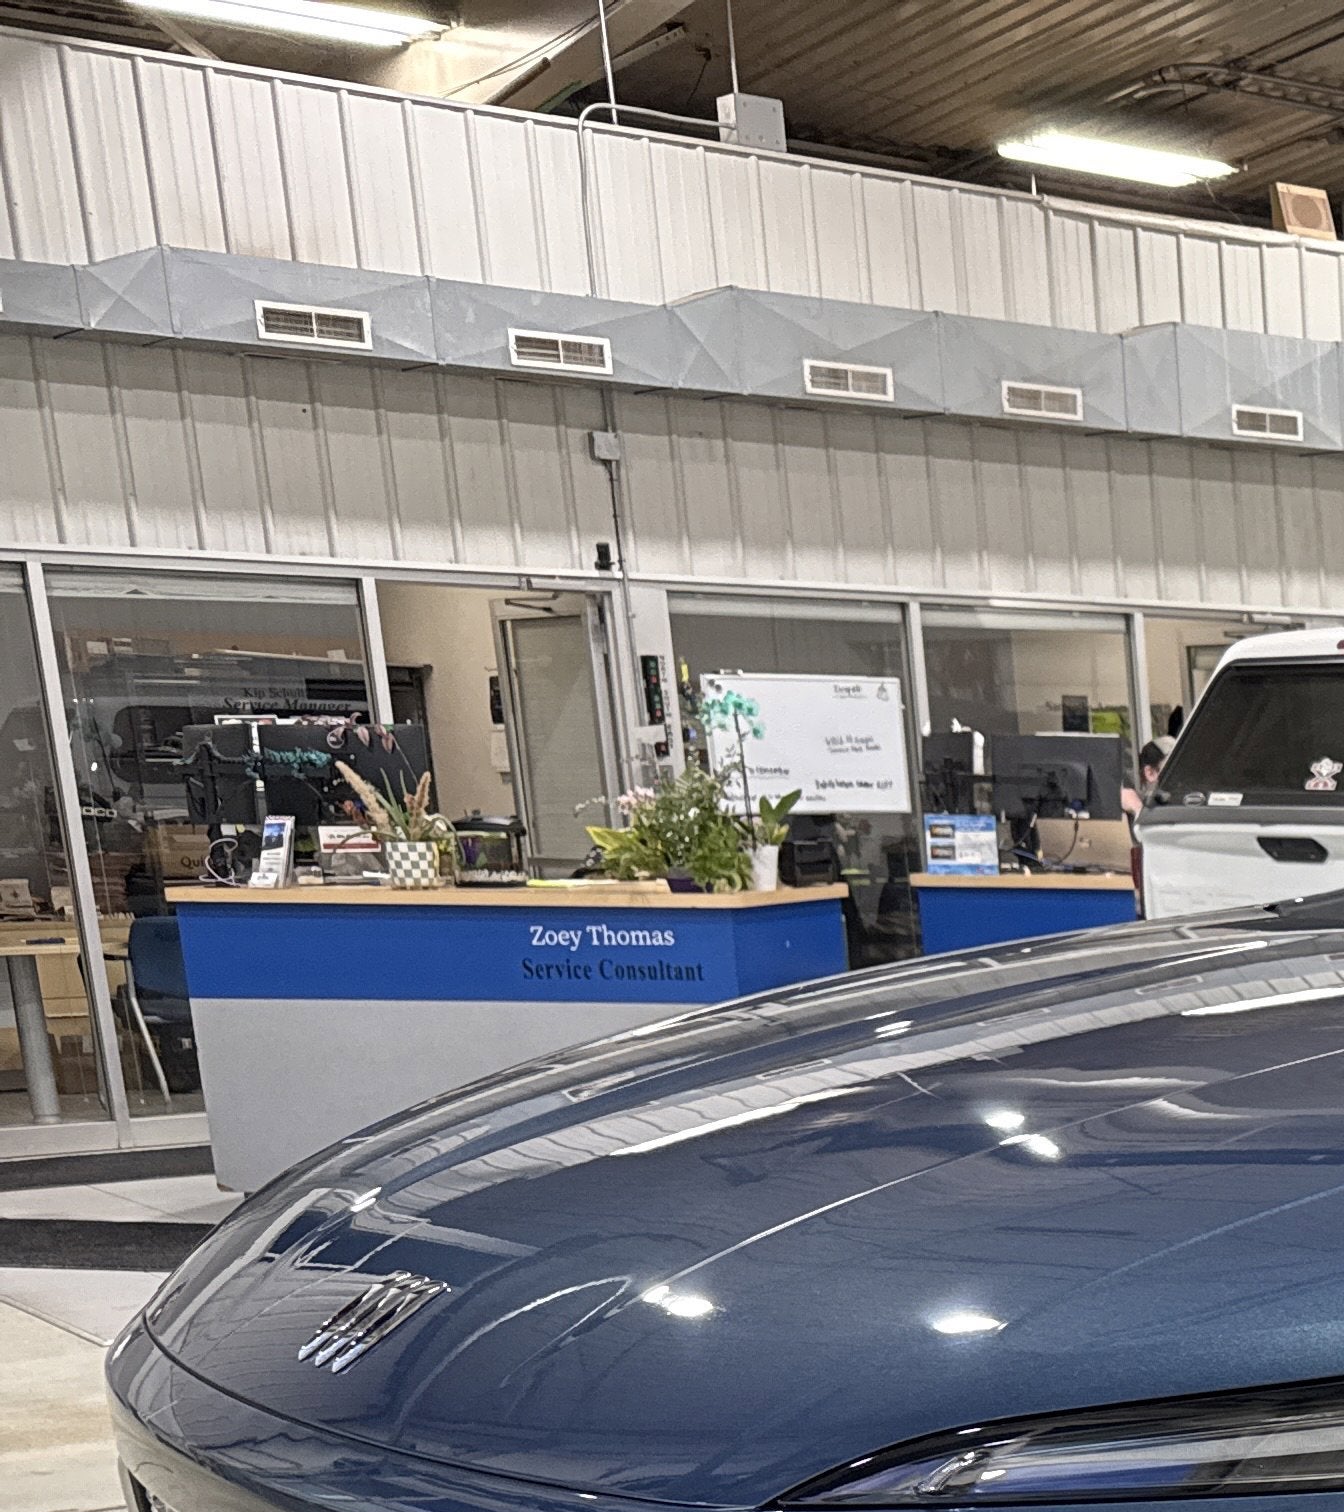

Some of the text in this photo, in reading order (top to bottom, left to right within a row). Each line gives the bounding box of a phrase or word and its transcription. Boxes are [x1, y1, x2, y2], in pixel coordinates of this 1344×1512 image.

[529, 924, 676, 952] Zoey Thomas
[521, 957, 706, 982] Service Consultant
